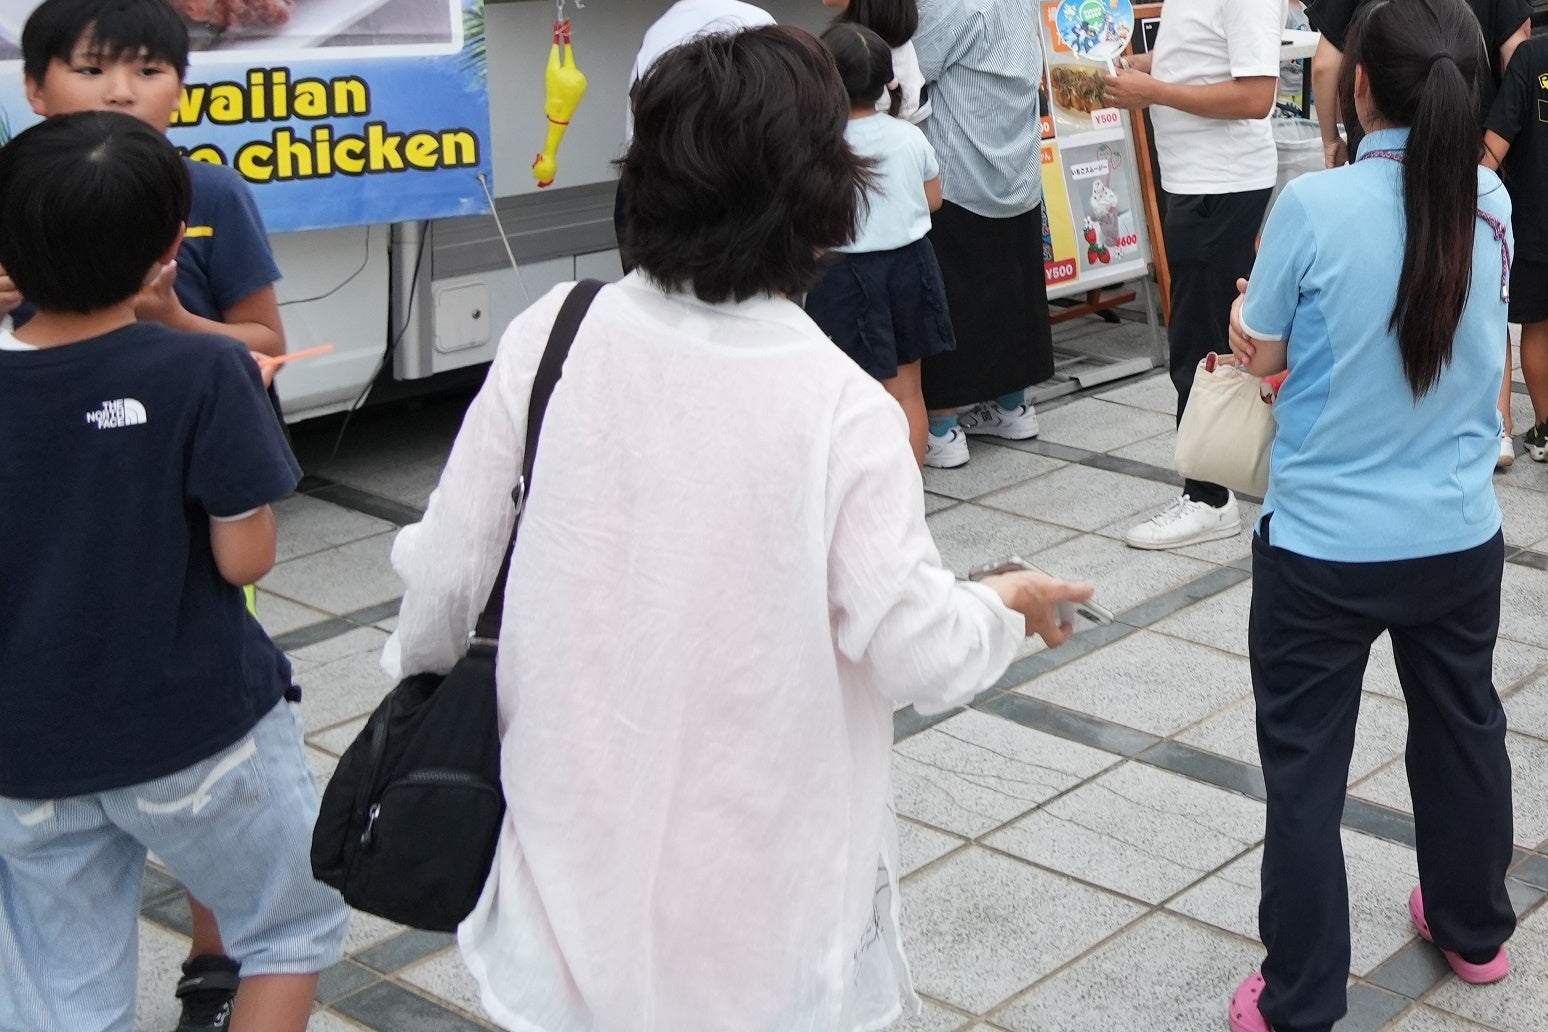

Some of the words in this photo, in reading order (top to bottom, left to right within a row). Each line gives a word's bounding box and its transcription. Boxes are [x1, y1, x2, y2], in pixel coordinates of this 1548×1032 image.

[1095, 112, 1118, 123] ¥500
[238, 124, 477, 180] chicken
[1045, 265, 1073, 280] ¥500
[102, 399, 124, 411] THE
[86, 408, 124, 424] NORTH
[98, 418, 125, 429] FACE
